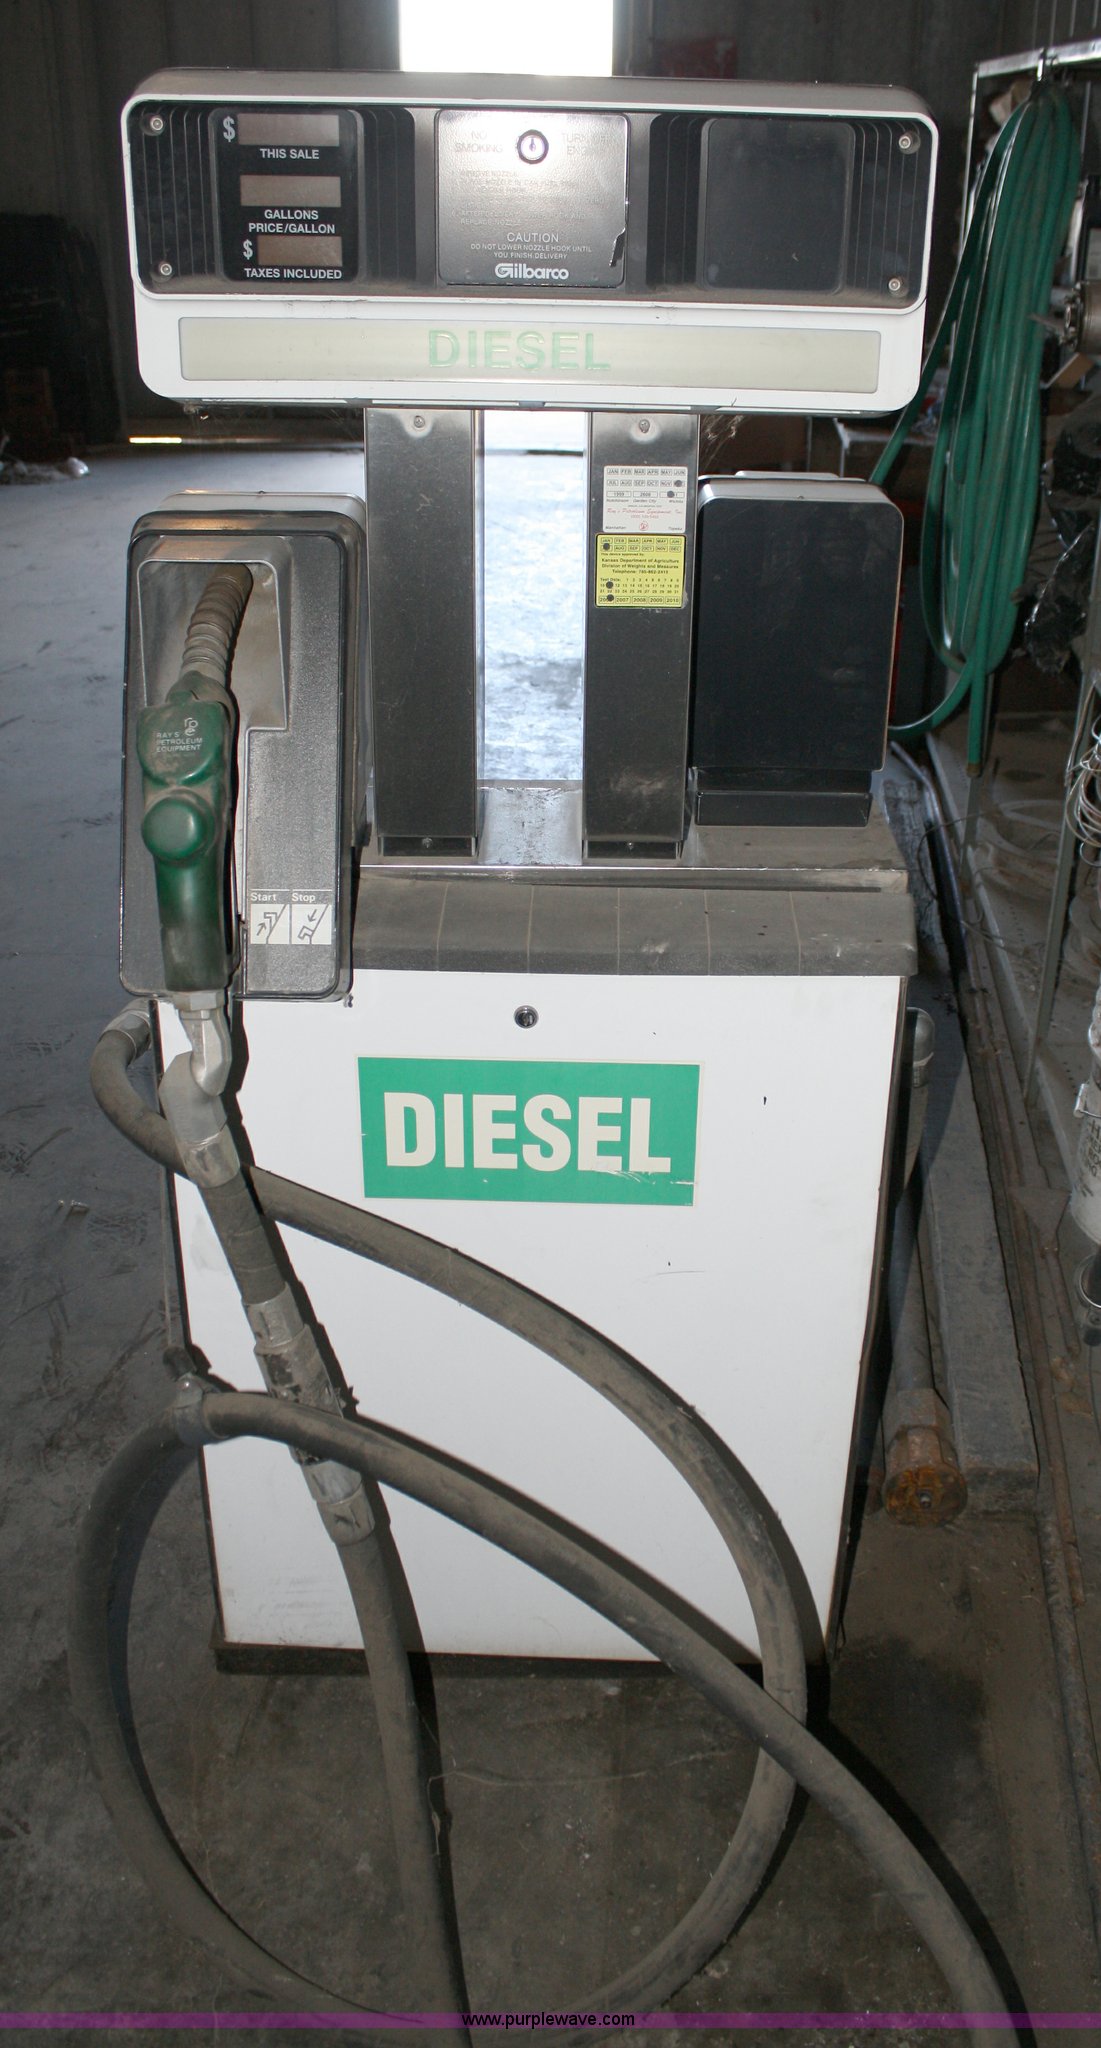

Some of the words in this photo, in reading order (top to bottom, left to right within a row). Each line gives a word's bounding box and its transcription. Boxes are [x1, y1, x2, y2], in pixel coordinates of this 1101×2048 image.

[223, 116, 235, 142] $
[471, 132, 487, 141] NO
[454, 143, 503, 153] SMOKING
[260, 148, 287, 159] THIS
[290, 149, 320, 160] SALE
[264, 209, 319, 220] GALLONS
[248, 223, 335, 234] PRICE/GALLON
[506, 232, 559, 243] CAUTION
[242, 239, 254, 261] $
[498, 243, 522, 251] LOWER
[572, 245, 592, 253] UNTIL
[244, 268, 280, 278] TAXES
[283, 268, 342, 280] INCLUDED
[494, 263, 569, 280] Gilbarco
[428, 330, 611, 370] DIESEL
[156, 738, 203, 746] PETROLEUM
[156, 744, 202, 753] EQUIPMENT
[250, 892, 277, 901] Start
[291, 892, 316, 903] Stop
[383, 1091, 672, 1173] DIESEL
